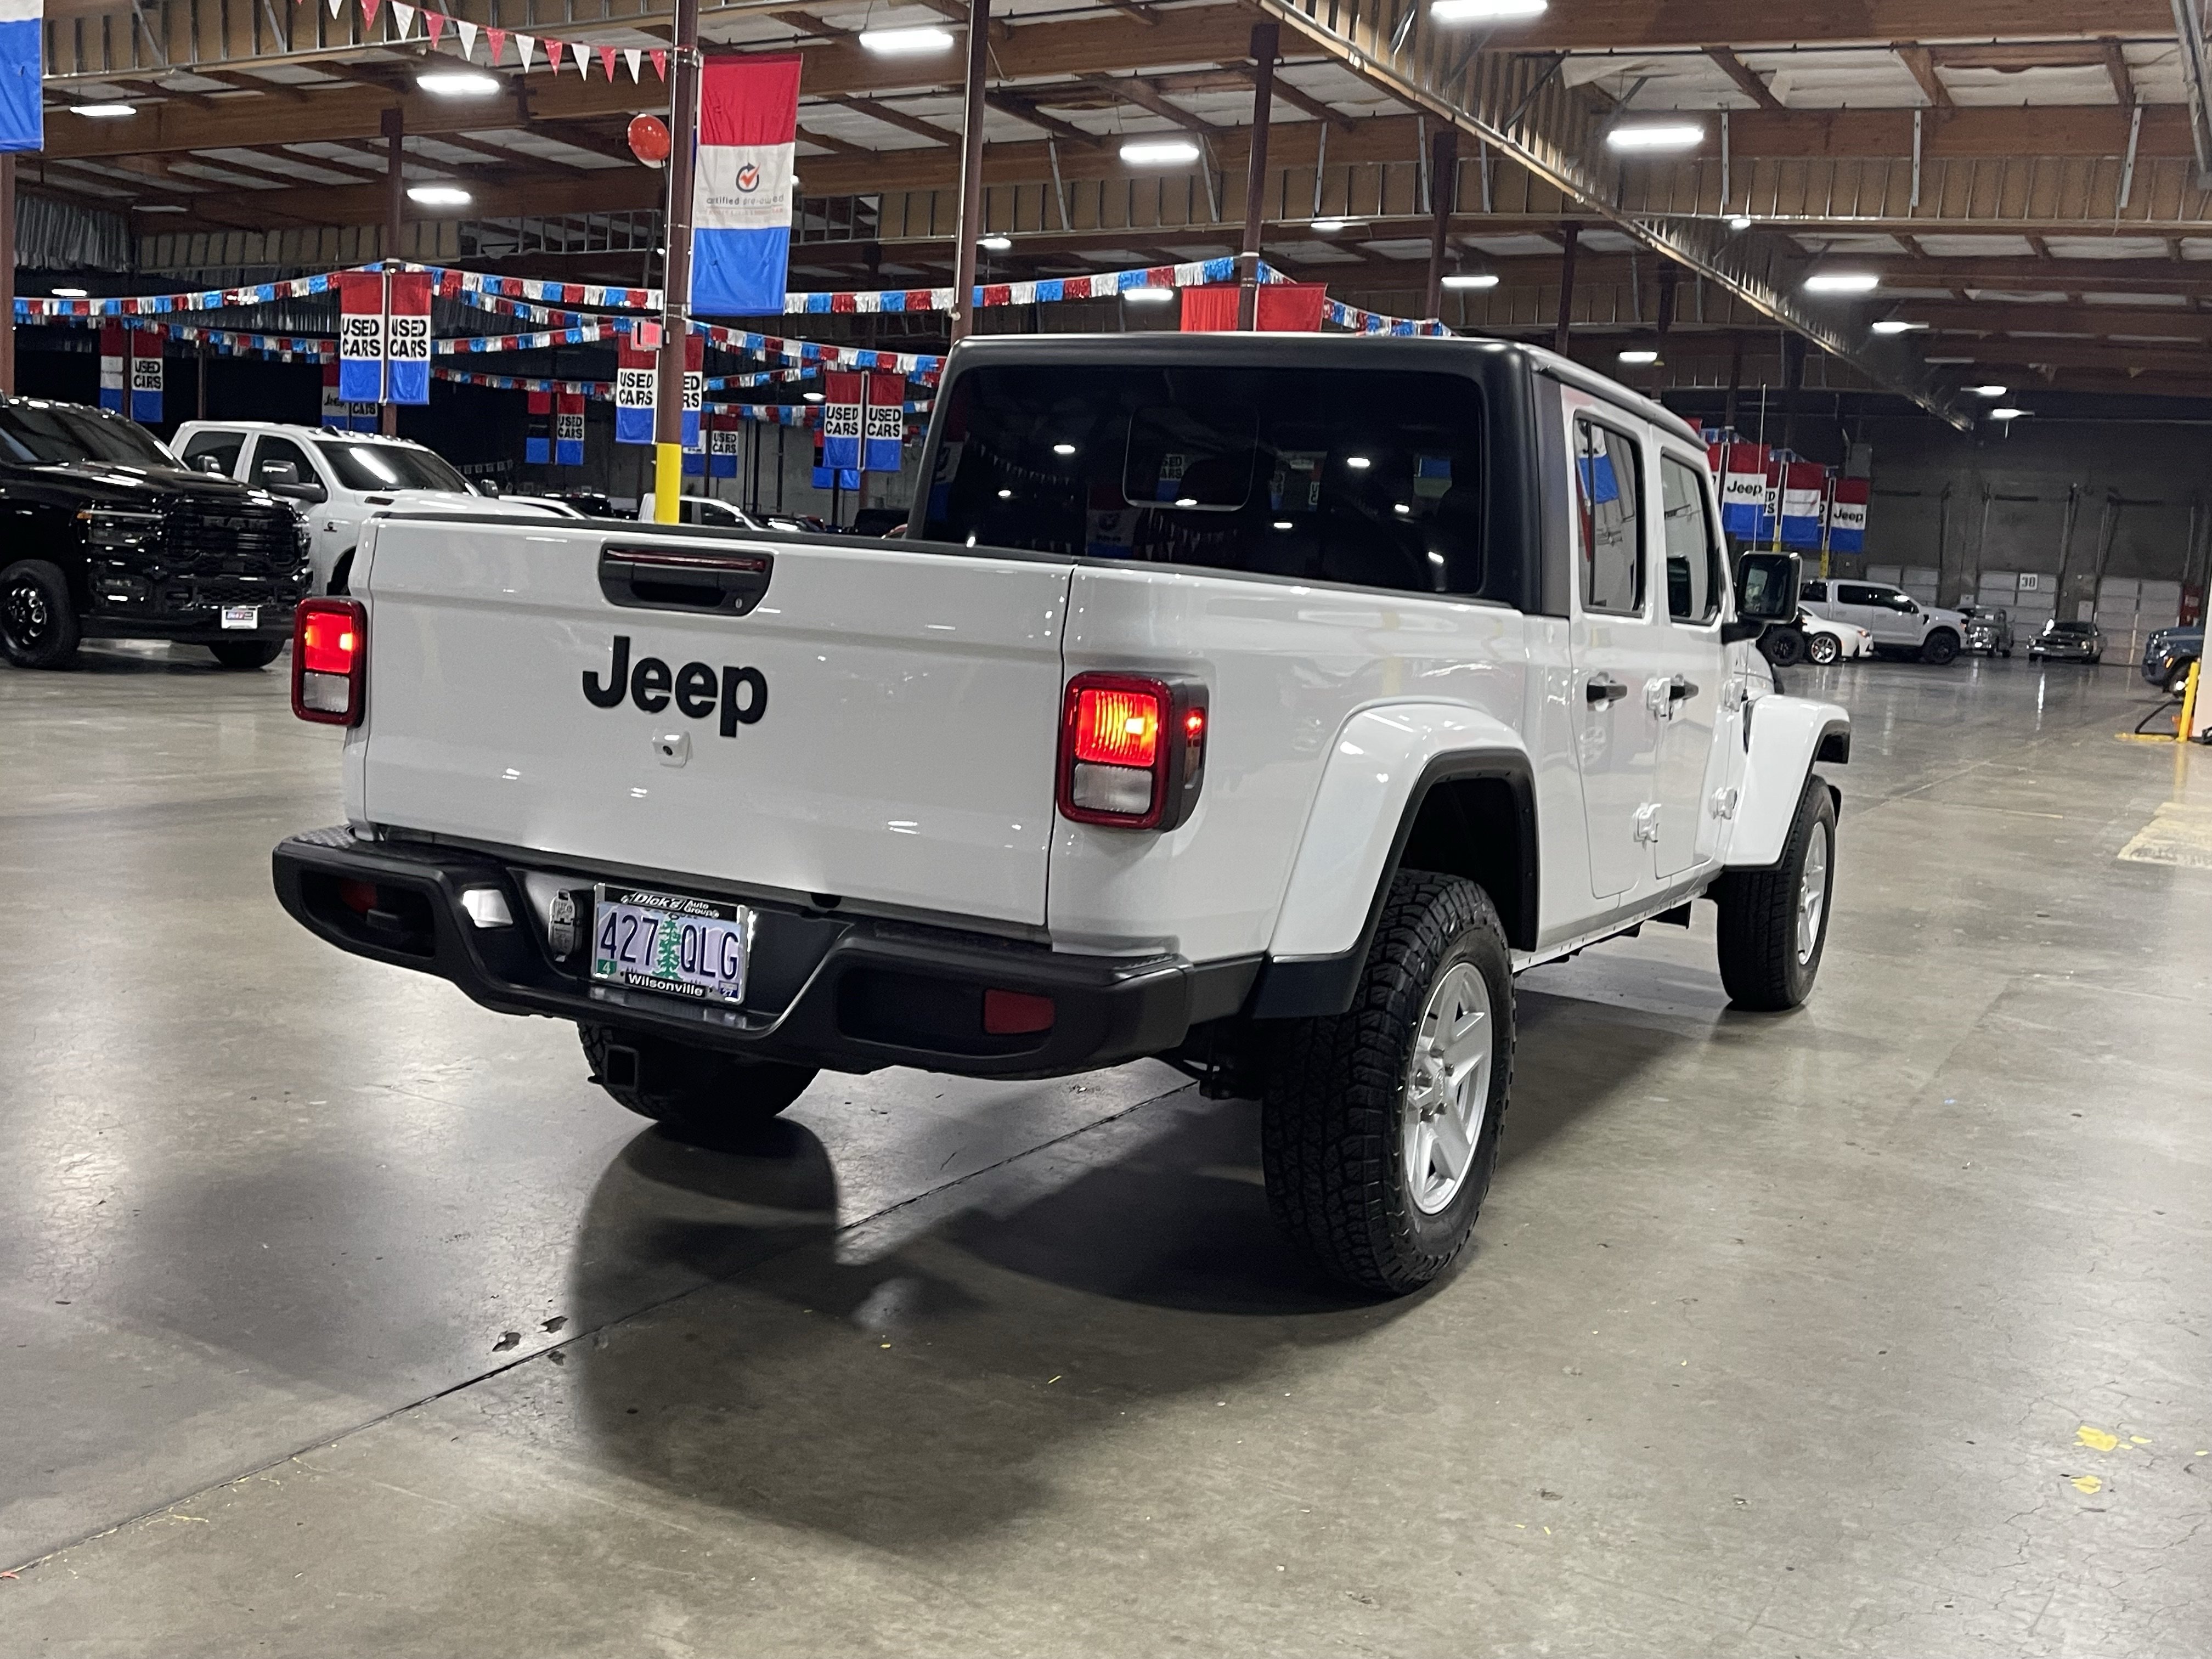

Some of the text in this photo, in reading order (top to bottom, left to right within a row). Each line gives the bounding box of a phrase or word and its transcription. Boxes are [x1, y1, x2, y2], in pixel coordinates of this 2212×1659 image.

[342, 318, 380, 336] USED
[391, 319, 427, 337] USED
[342, 338, 381, 357] CARS
[390, 339, 427, 357] CARS
[134, 360, 161, 374] USED
[620, 372, 653, 388] USED
[684, 375, 700, 390] ED
[619, 389, 653, 405] CARS
[826, 406, 859, 420] USED
[868, 408, 901, 422] USED
[558, 416, 583, 427] USED
[826, 421, 859, 435] CARS
[867, 423, 900, 437] CARS
[714, 433, 736, 443] USED
[713, 443, 736, 453] CARS
[1727, 480, 1763, 496] Jeep
[1833, 508, 1864, 523] Jeep
[582, 635, 768, 738] Jeep
[687, 900, 709, 910] Auto
[601, 912, 739, 980] 427 QLG
[602, 962, 611, 974] 4
[628, 973, 703, 996] Wilsonville
